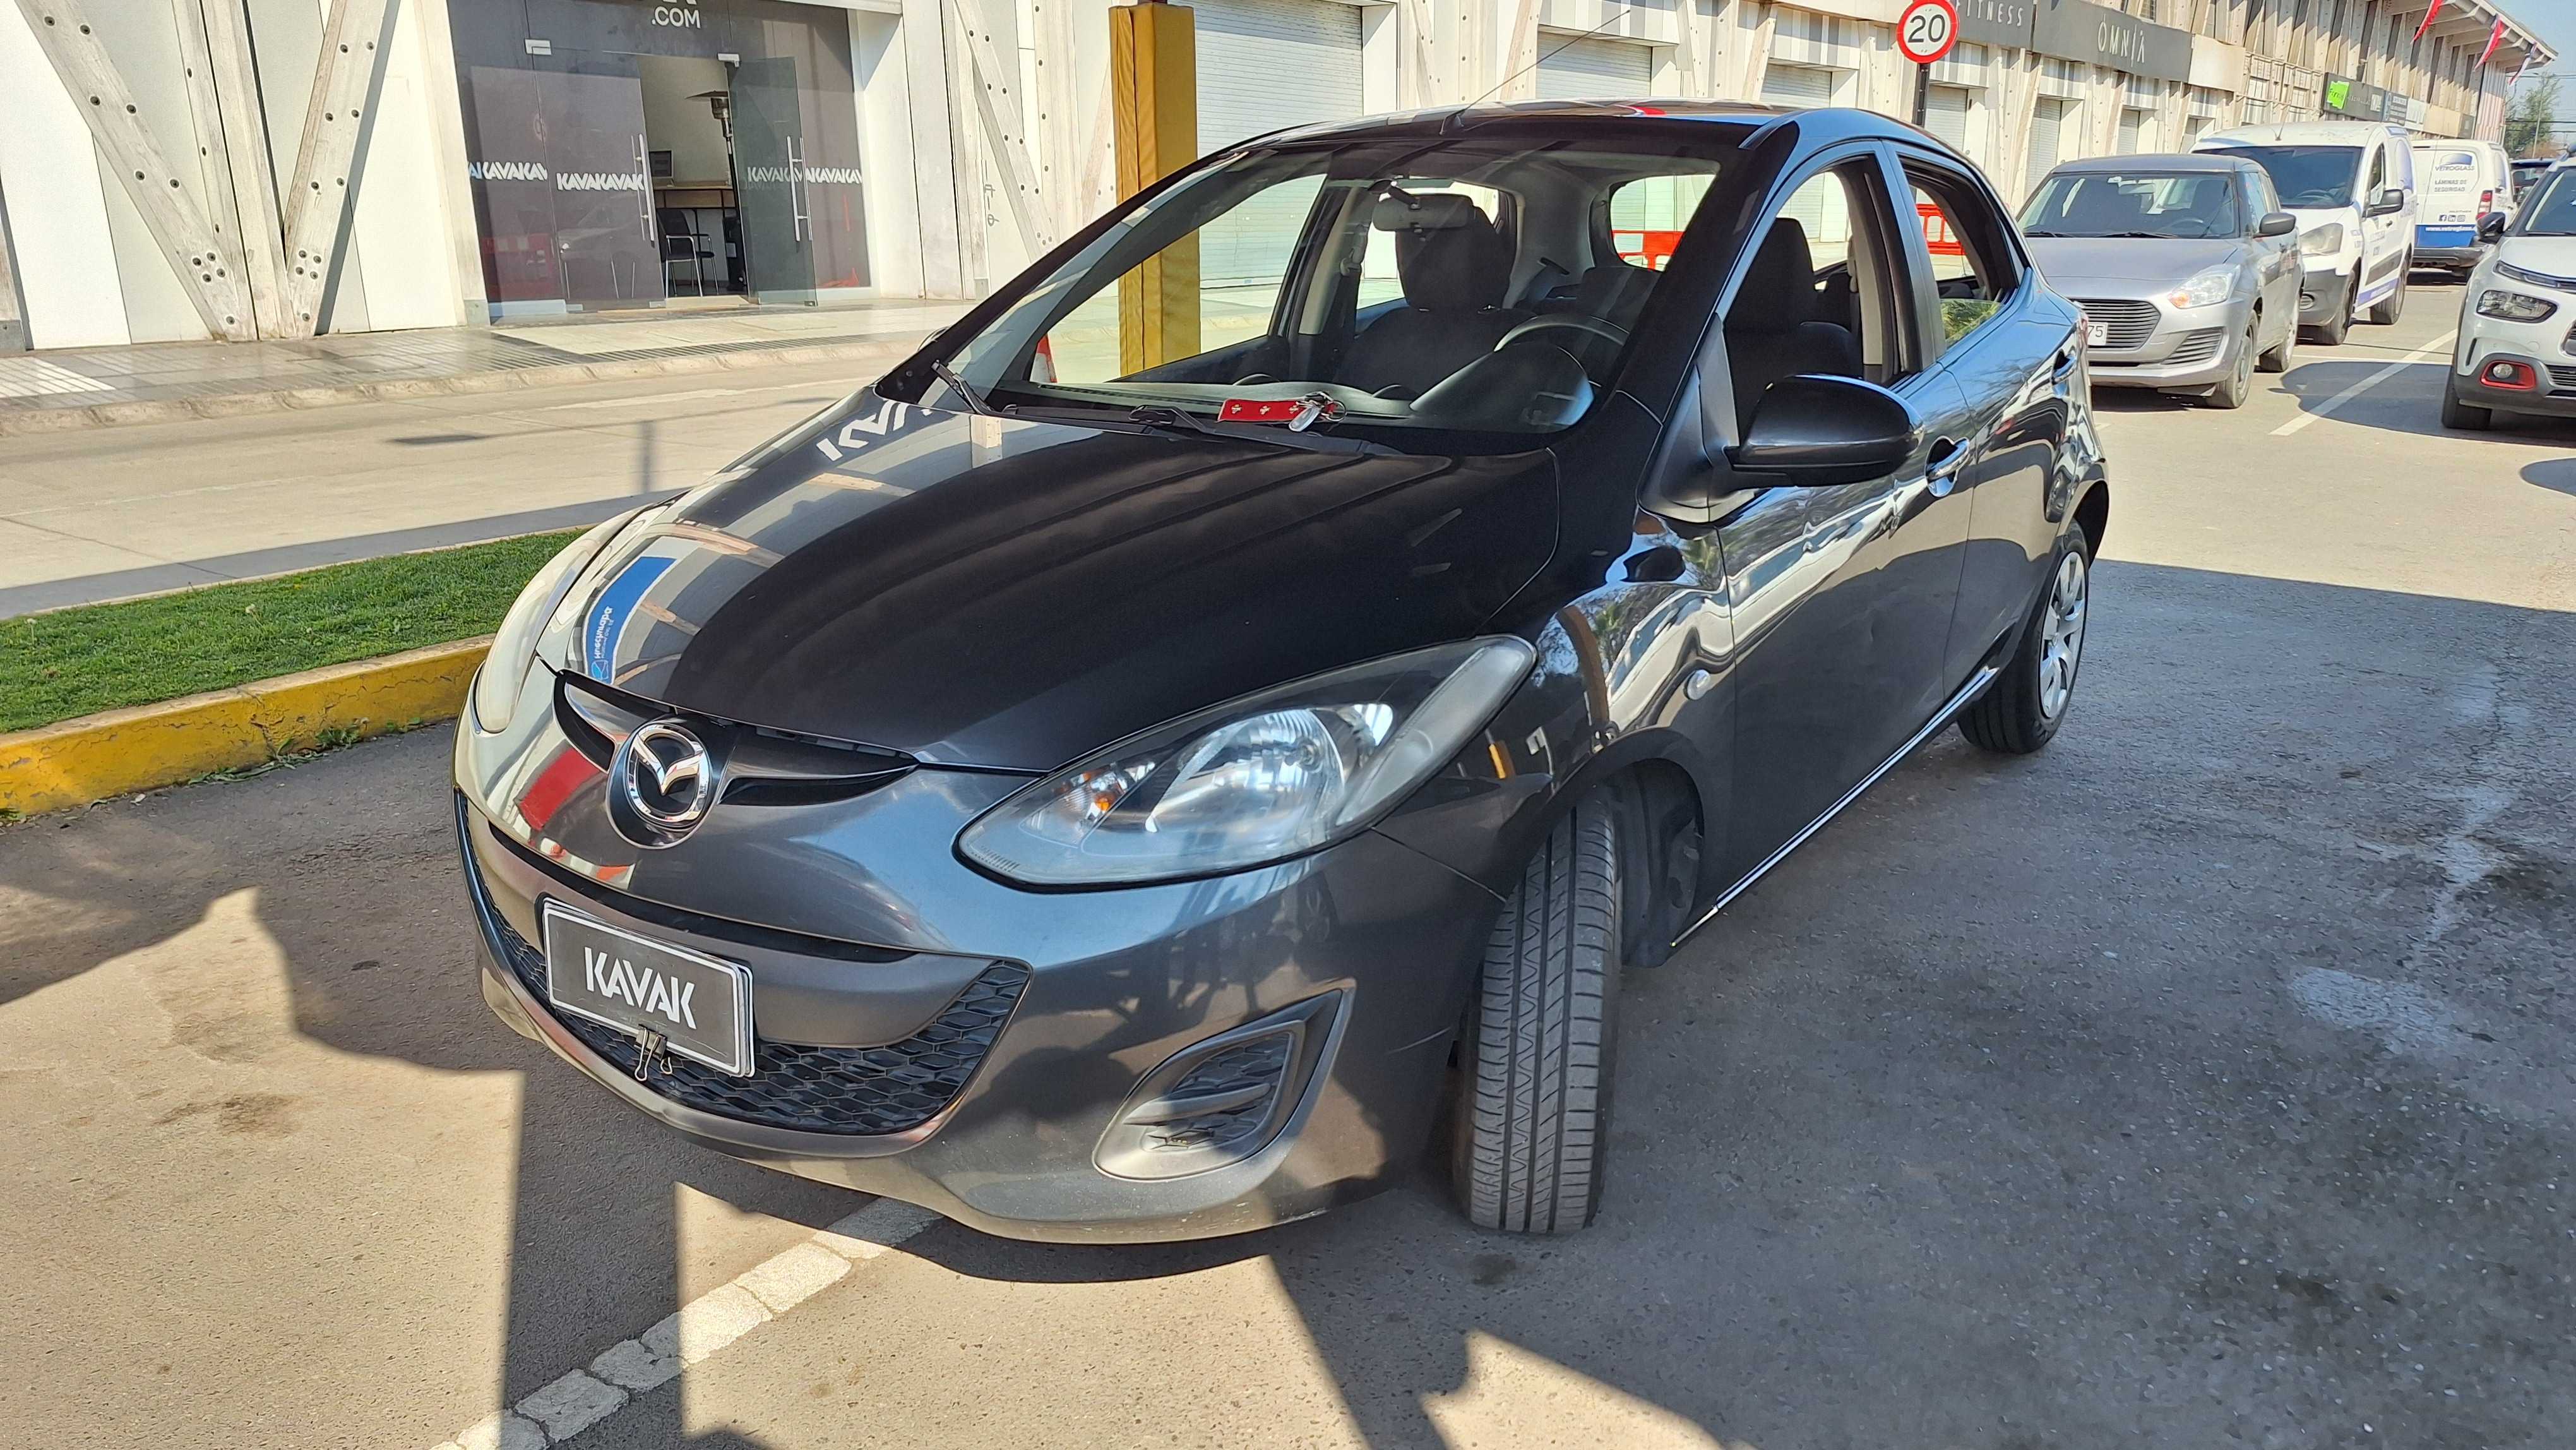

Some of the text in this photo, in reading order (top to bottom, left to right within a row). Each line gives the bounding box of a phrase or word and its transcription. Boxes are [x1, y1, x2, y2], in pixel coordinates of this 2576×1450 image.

[652, 6, 701, 28] .COM
[1907, 14, 1945, 43] 20
[2097, 13, 2145, 67] OMNIA
[2088, 325, 2104, 338] 75
[584, 947, 697, 1030] KAVAK
